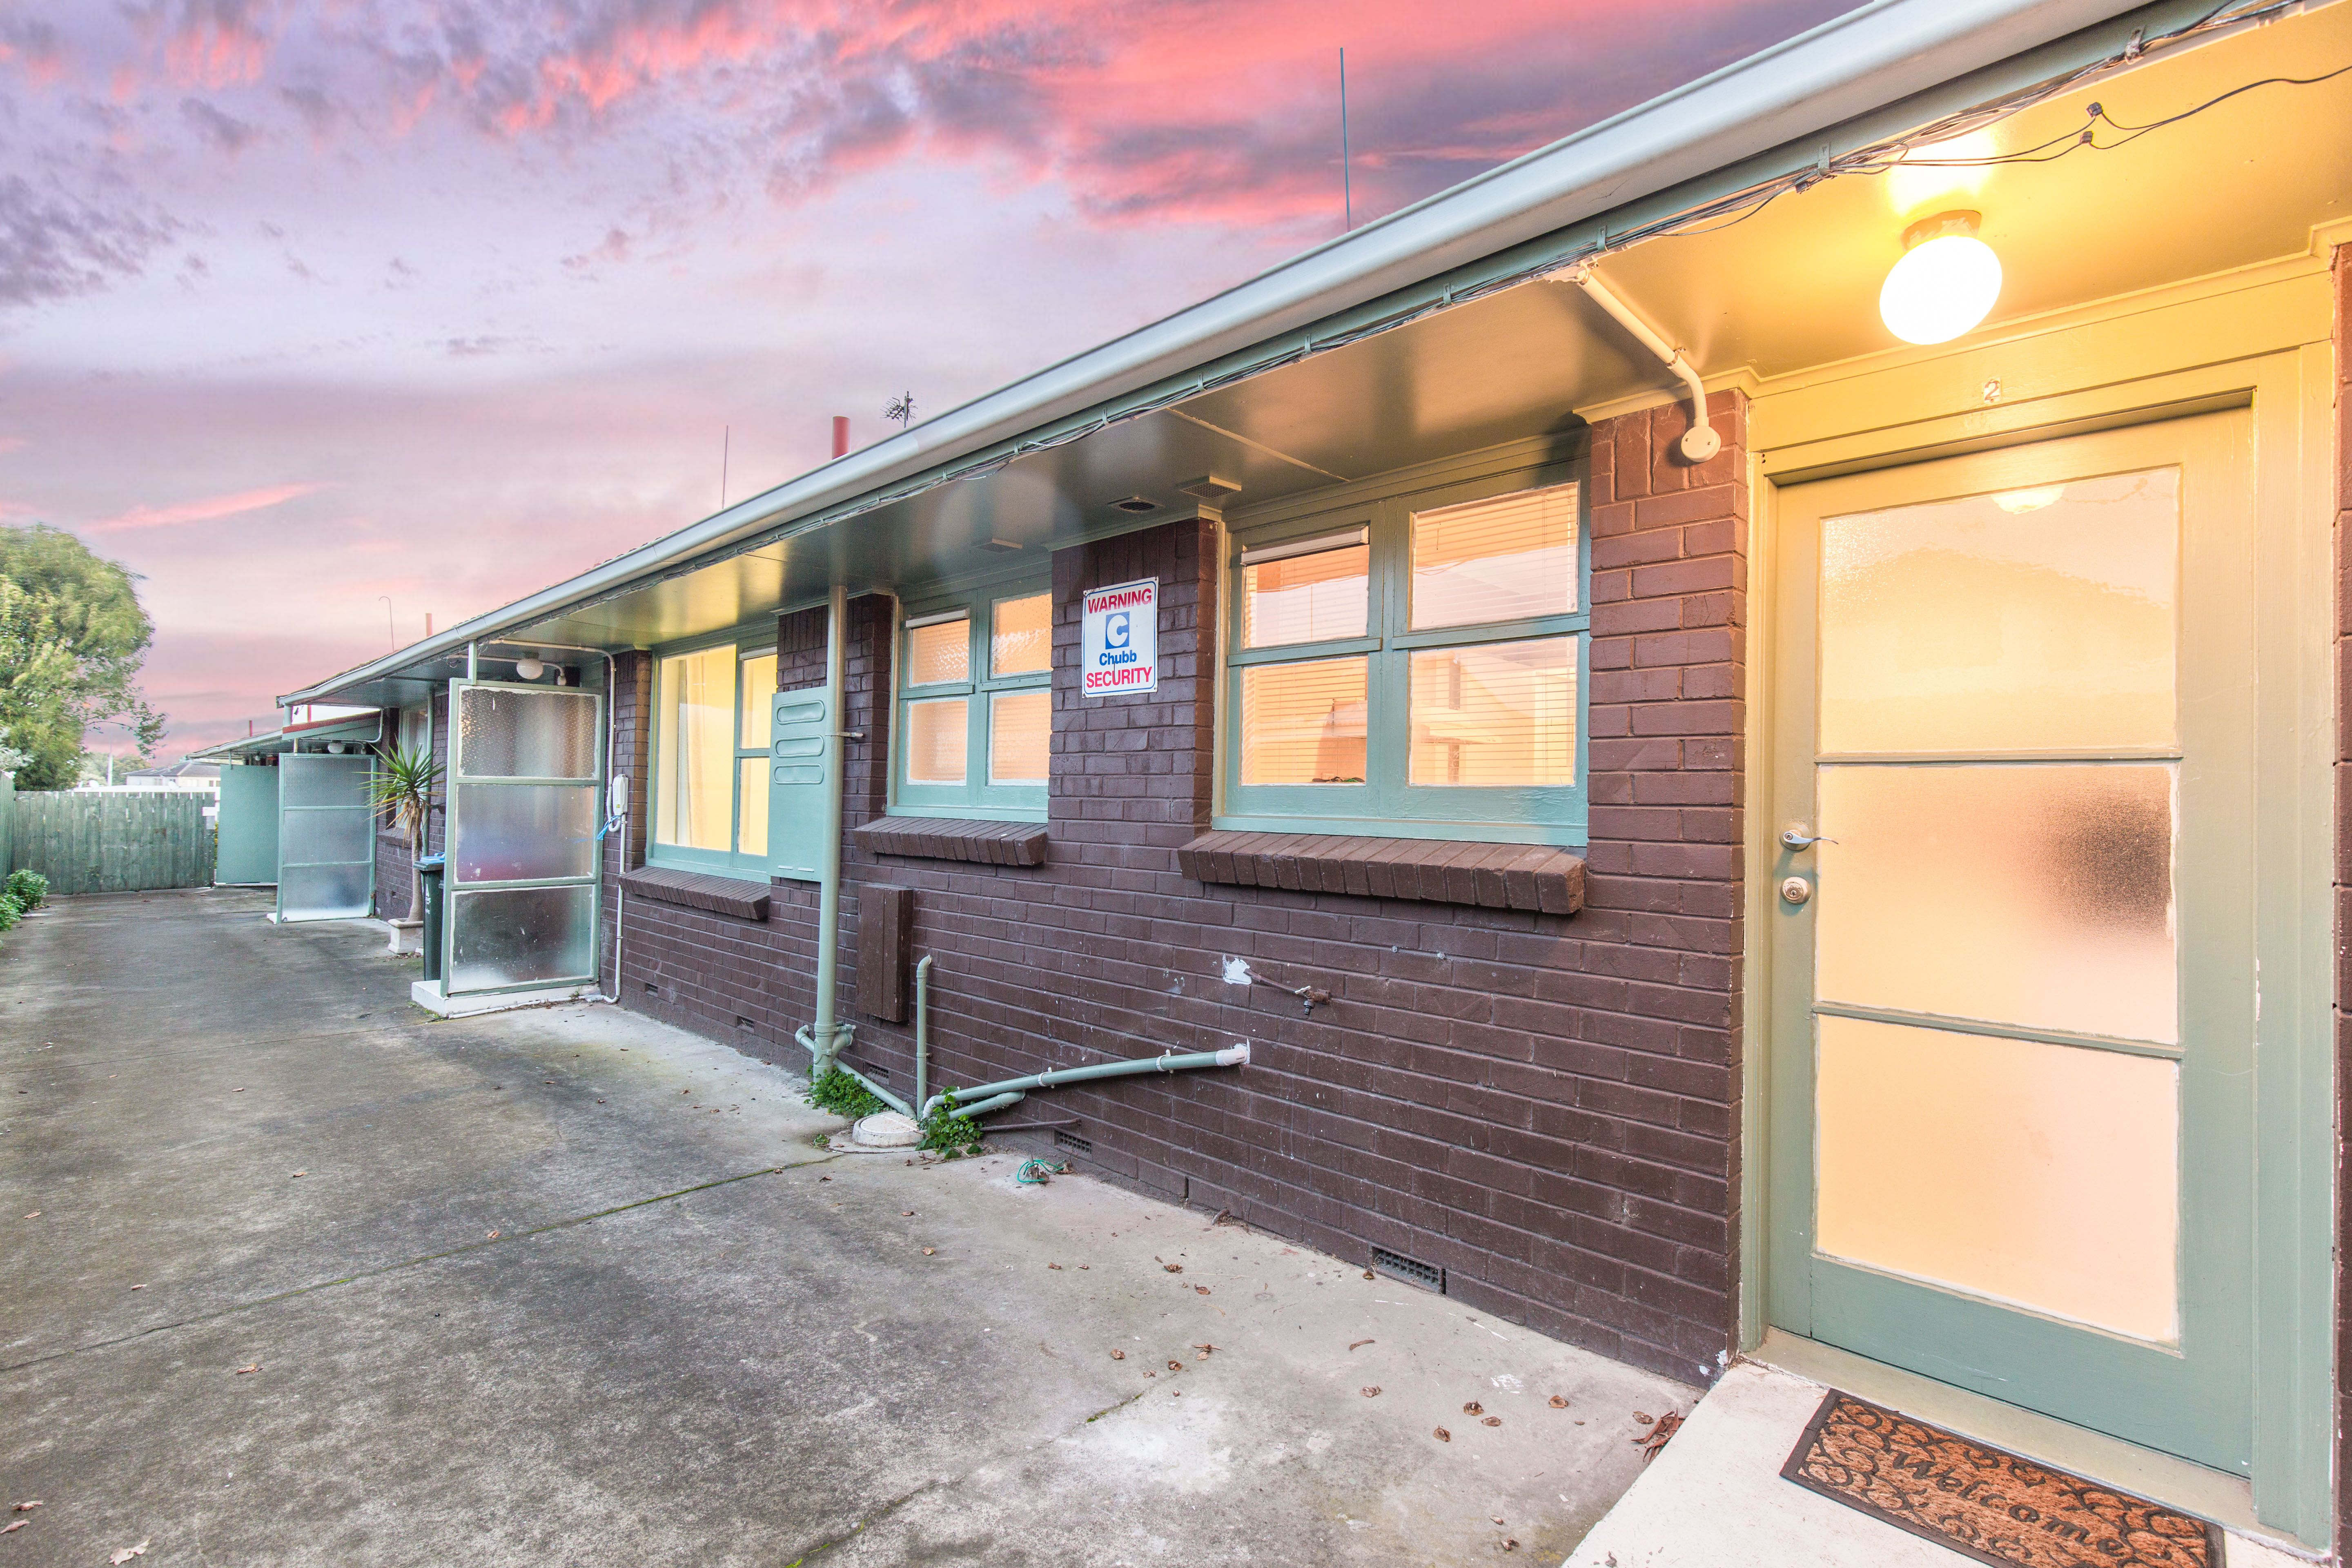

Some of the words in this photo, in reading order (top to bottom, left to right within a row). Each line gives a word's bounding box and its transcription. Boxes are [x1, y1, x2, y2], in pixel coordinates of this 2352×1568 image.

[1984, 381, 2000, 401] 2
[1087, 588, 1152, 614] WARNING
[1099, 650, 1137, 666] Chubb
[1086, 666, 1153, 688] SECURITY
